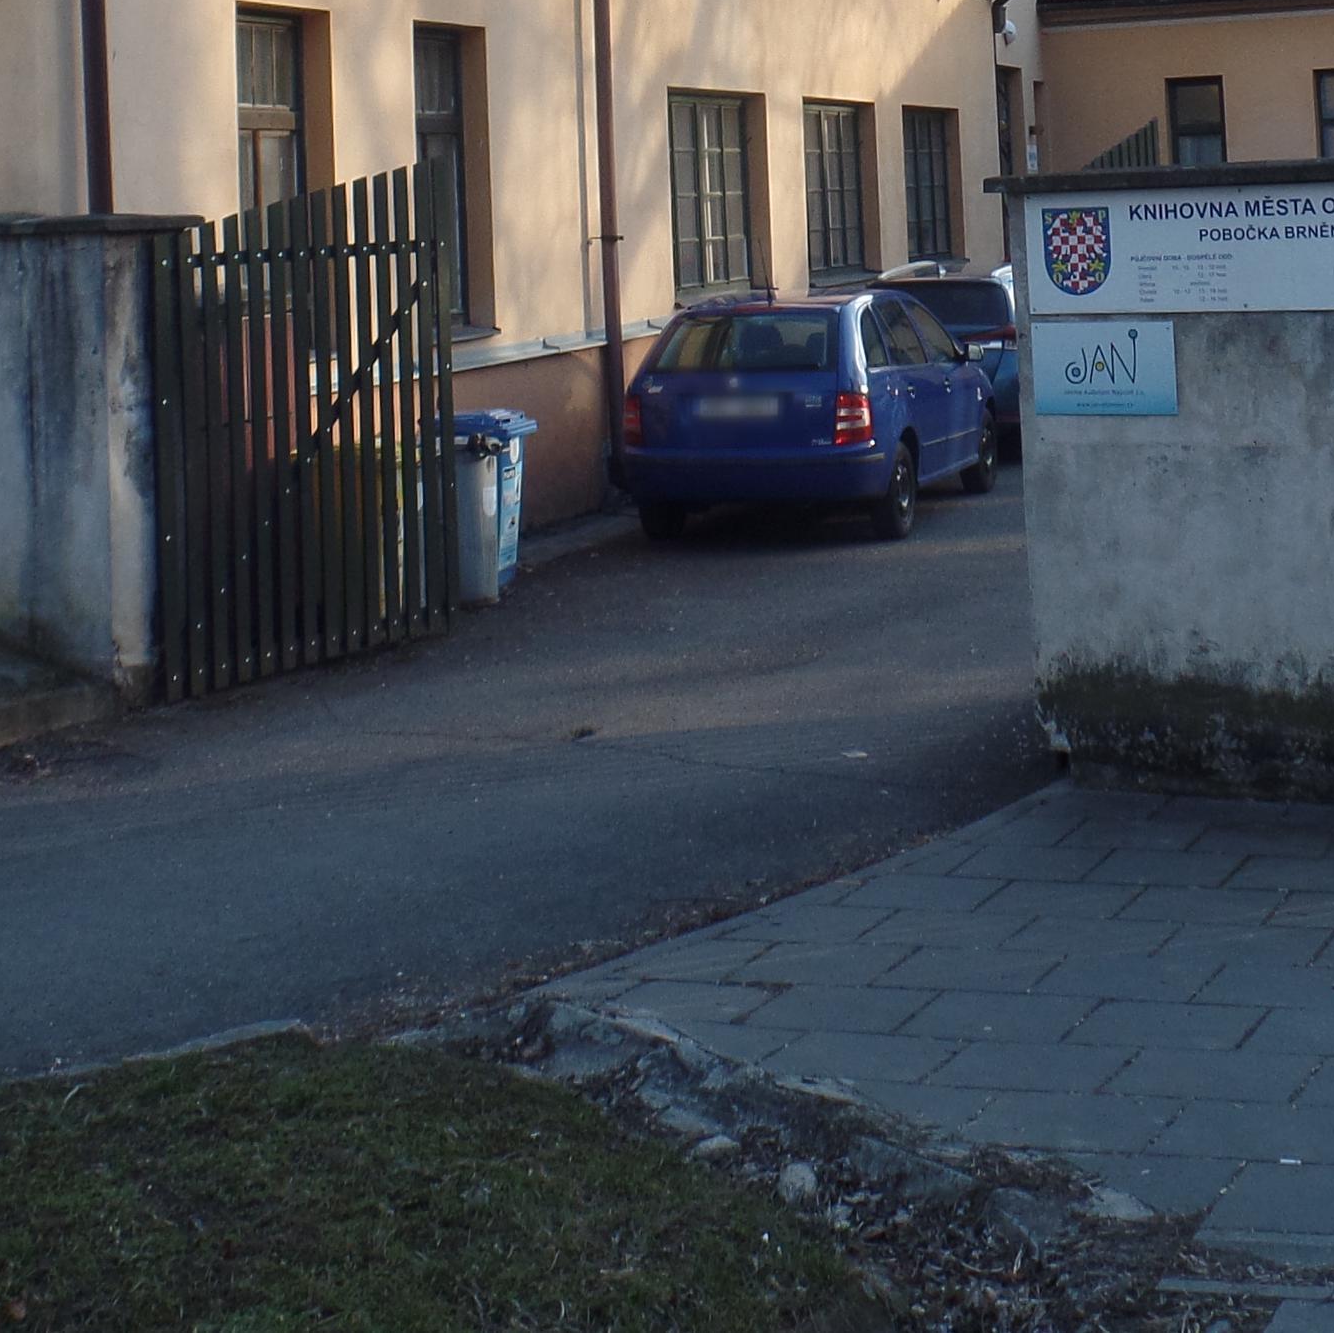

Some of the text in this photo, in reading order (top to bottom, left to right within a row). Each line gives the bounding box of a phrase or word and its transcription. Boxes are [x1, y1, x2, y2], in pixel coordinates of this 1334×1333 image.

[1128, 201, 1239, 221] KNIHOVNA
[1244, 196, 1316, 217] MĚSTA
[1199, 224, 1281, 242] POBOČKA
[1065, 328, 1139, 385] JAN
